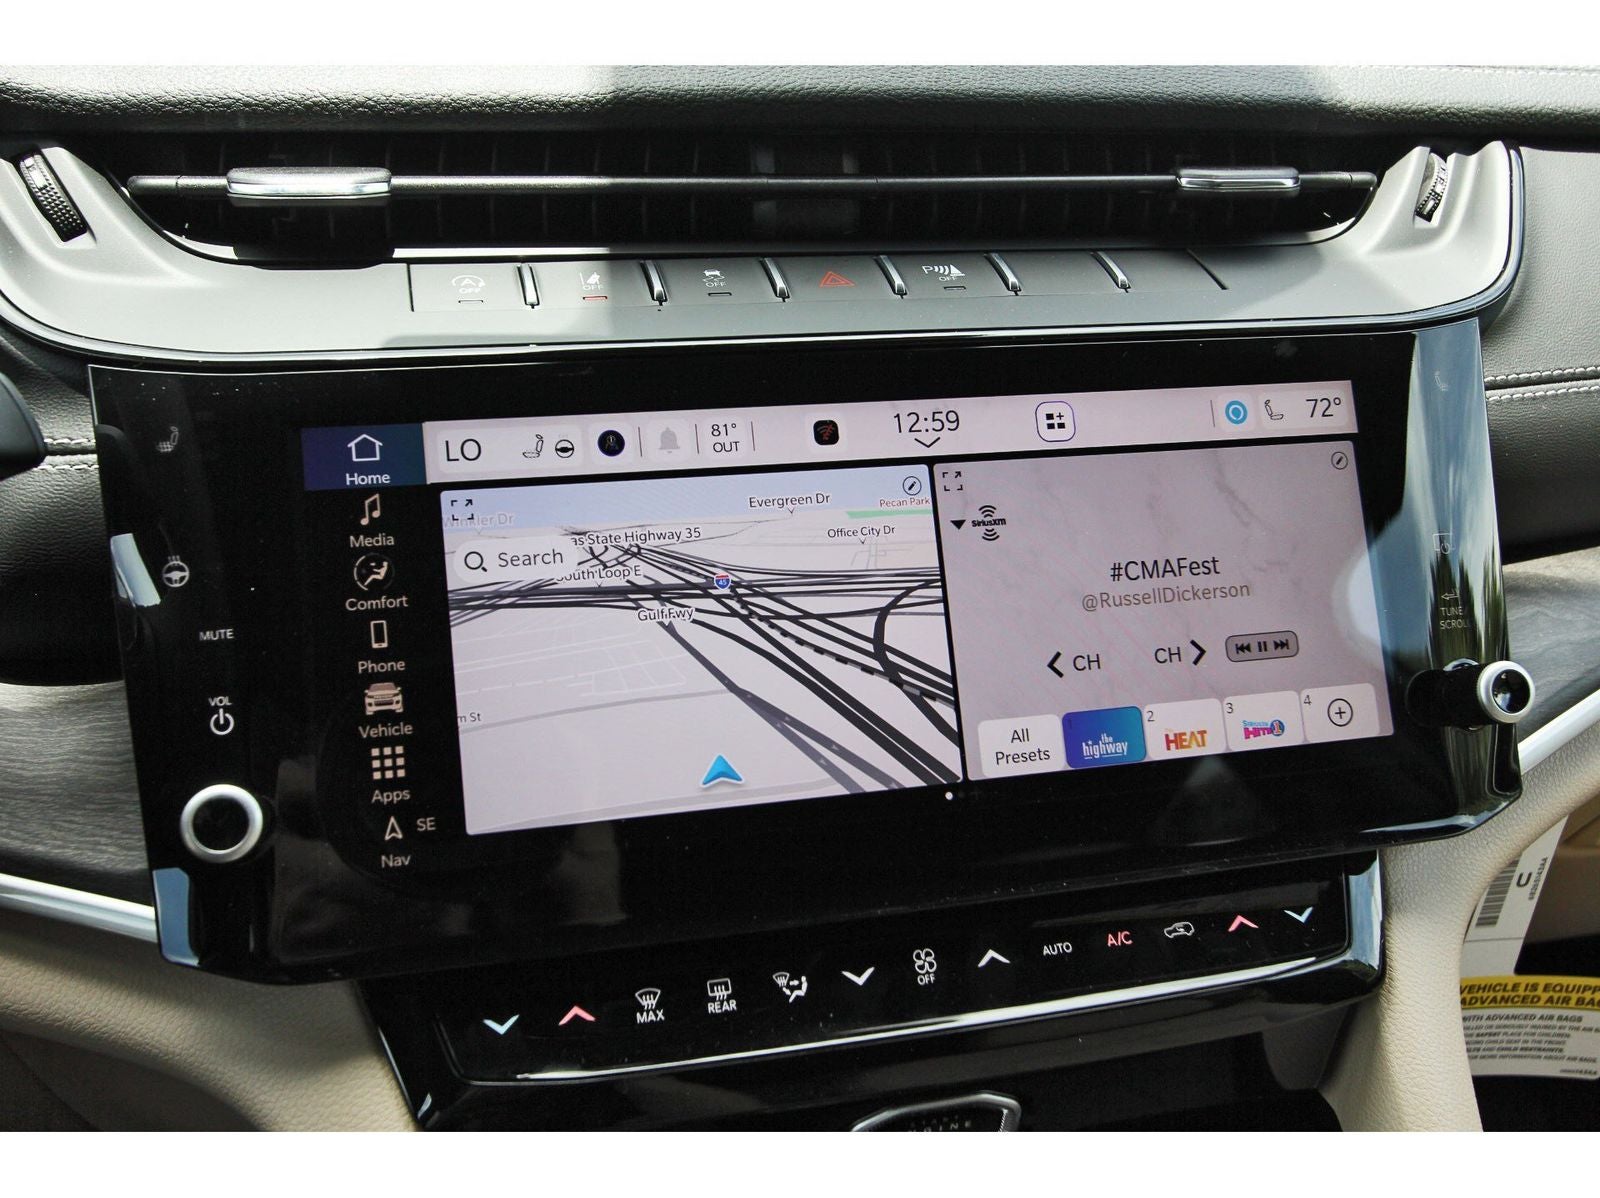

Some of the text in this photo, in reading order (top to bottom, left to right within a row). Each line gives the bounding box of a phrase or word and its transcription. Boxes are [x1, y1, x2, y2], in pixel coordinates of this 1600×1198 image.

[459, 286, 480, 295] OFF
[582, 283, 604, 291] OFF
[705, 280, 727, 288] OFF
[893, 409, 961, 435] 12:59
[444, 438, 482, 463] LO
[712, 440, 740, 454] OUT
[345, 472, 391, 486] Home
[748, 492, 831, 509] Evergreen Dr
[879, 496, 930, 508] Pecan Park
[498, 512, 514, 525] Dr
[587, 533, 622, 545] State
[625, 528, 682, 544] Highway
[685, 527, 701, 539] 35
[827, 525, 896, 539] Office City Dr
[349, 532, 395, 548] Media
[497, 548, 564, 569] Search
[598, 566, 631, 580] Loop
[632, 565, 641, 577] E
[1110, 555, 1221, 582] #CMAFest
[718, 578, 728, 586] 45
[345, 595, 409, 611] Comfort
[1081, 582, 1251, 612] @RussellDickerson
[638, 608, 666, 622] Gulf
[1440, 606, 1464, 616] TUNE
[199, 628, 234, 642] MUTE
[1072, 653, 1102, 672] CH
[1154, 647, 1182, 664] CH
[358, 659, 406, 674] Phone
[208, 695, 232, 707] VOL
[1304, 694, 1312, 706] 4
[1225, 702, 1234, 715] 3
[469, 712, 481, 722] St
[1146, 711, 1155, 722] 2
[358, 722, 413, 738] Vehicle
[1010, 728, 1030, 744] All
[1101, 733, 1114, 743] the
[1164, 730, 1208, 751] HEAT
[995, 745, 1051, 766] Presets
[1082, 738, 1128, 759] highway
[371, 788, 411, 804] Apps
[416, 816, 437, 833] SE
[381, 854, 411, 869] Nav
[1107, 929, 1133, 948] A/C
[1042, 941, 1073, 957] AUTO
[917, 973, 936, 986] OFF
[1460, 982, 1521, 995] VEHICLE
[1524, 982, 1540, 993] IS
[707, 999, 737, 1014] REAR
[1460, 994, 1541, 1007] ADVANCED
[1544, 995, 1572, 1006] AIR
[636, 1008, 665, 1025] MAX
[1485, 1013, 1537, 1021] ADVANCED
[1539, 1014, 1555, 1022] AIR
[1556, 1014, 1584, 1023] BAGS
